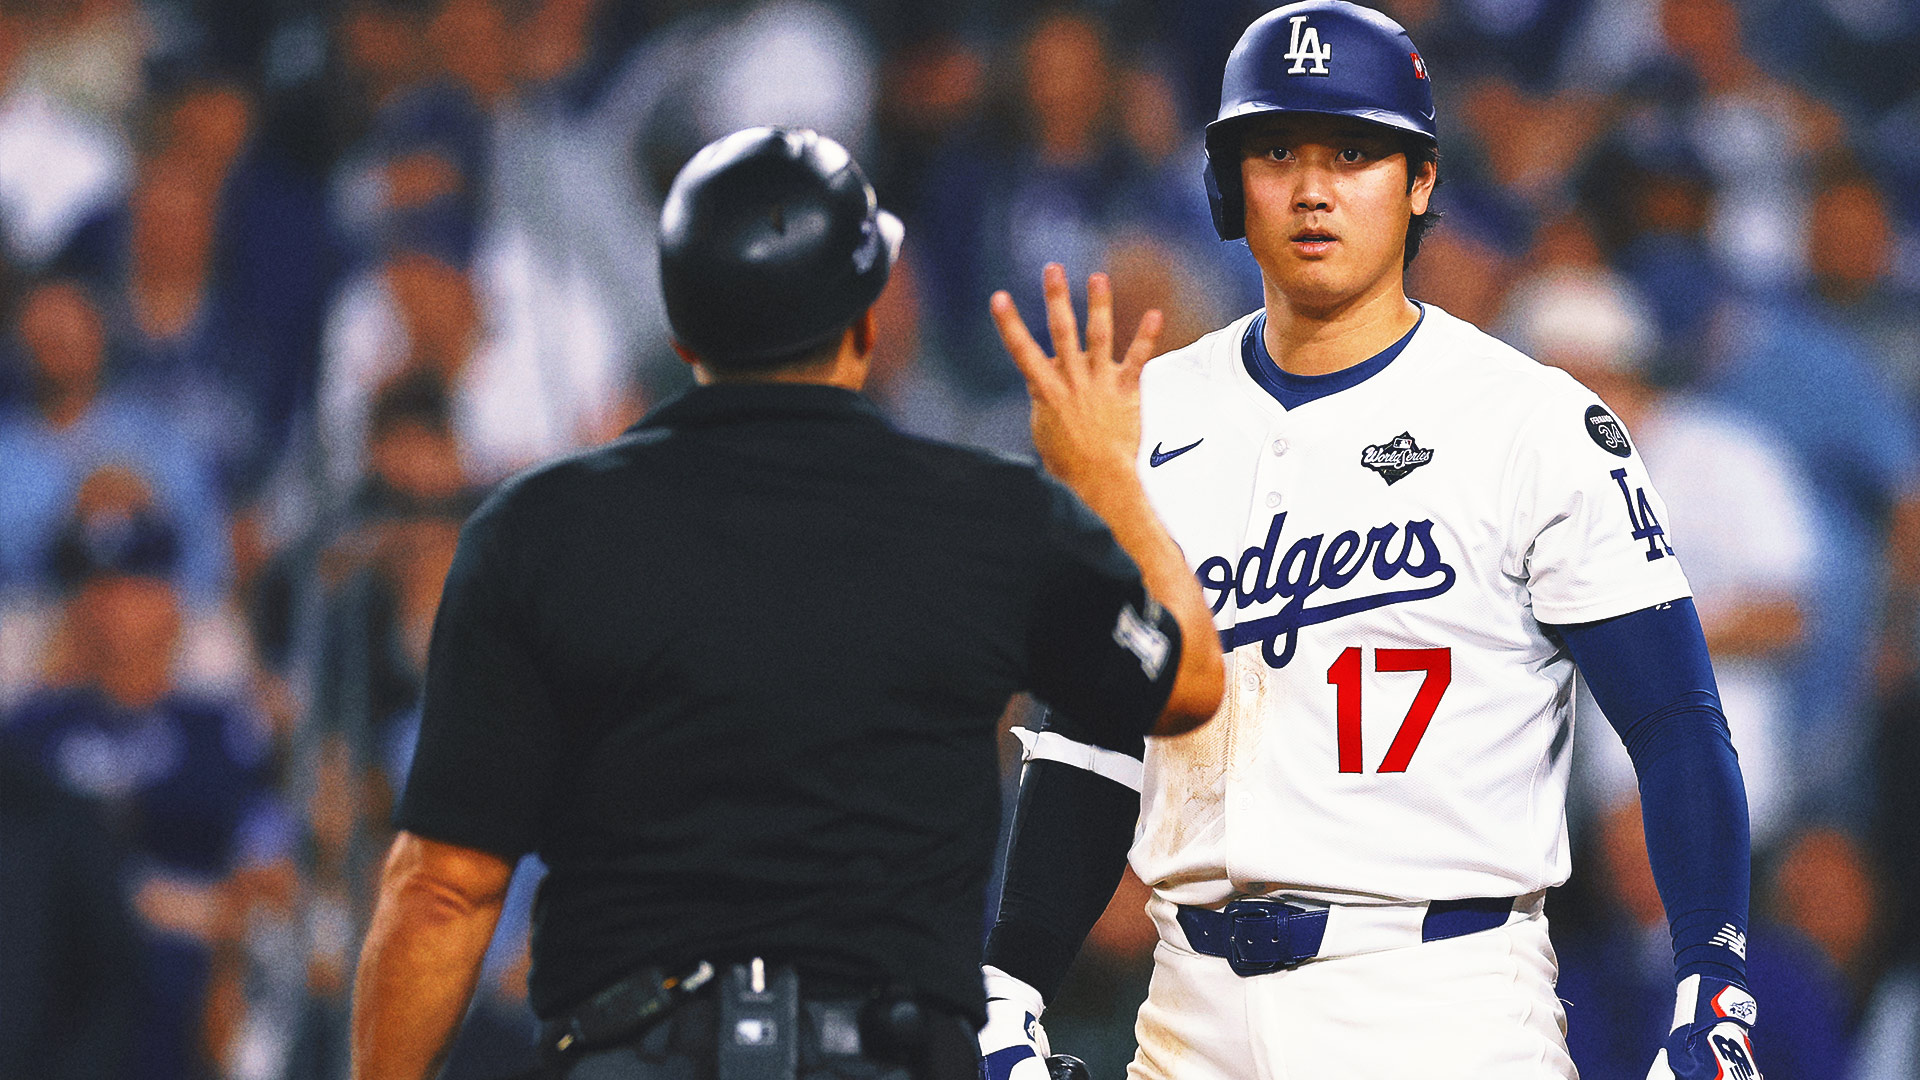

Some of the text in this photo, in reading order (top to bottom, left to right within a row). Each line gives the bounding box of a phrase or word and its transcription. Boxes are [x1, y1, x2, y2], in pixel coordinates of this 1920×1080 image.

[1284, 15, 1331, 75] LA
[1363, 446, 1431, 469] World Series
[1598, 423, 1628, 449] 34
[1610, 467, 1675, 562] LA
[1195, 511, 1456, 669] odgers
[1327, 646, 1452, 774] 17
